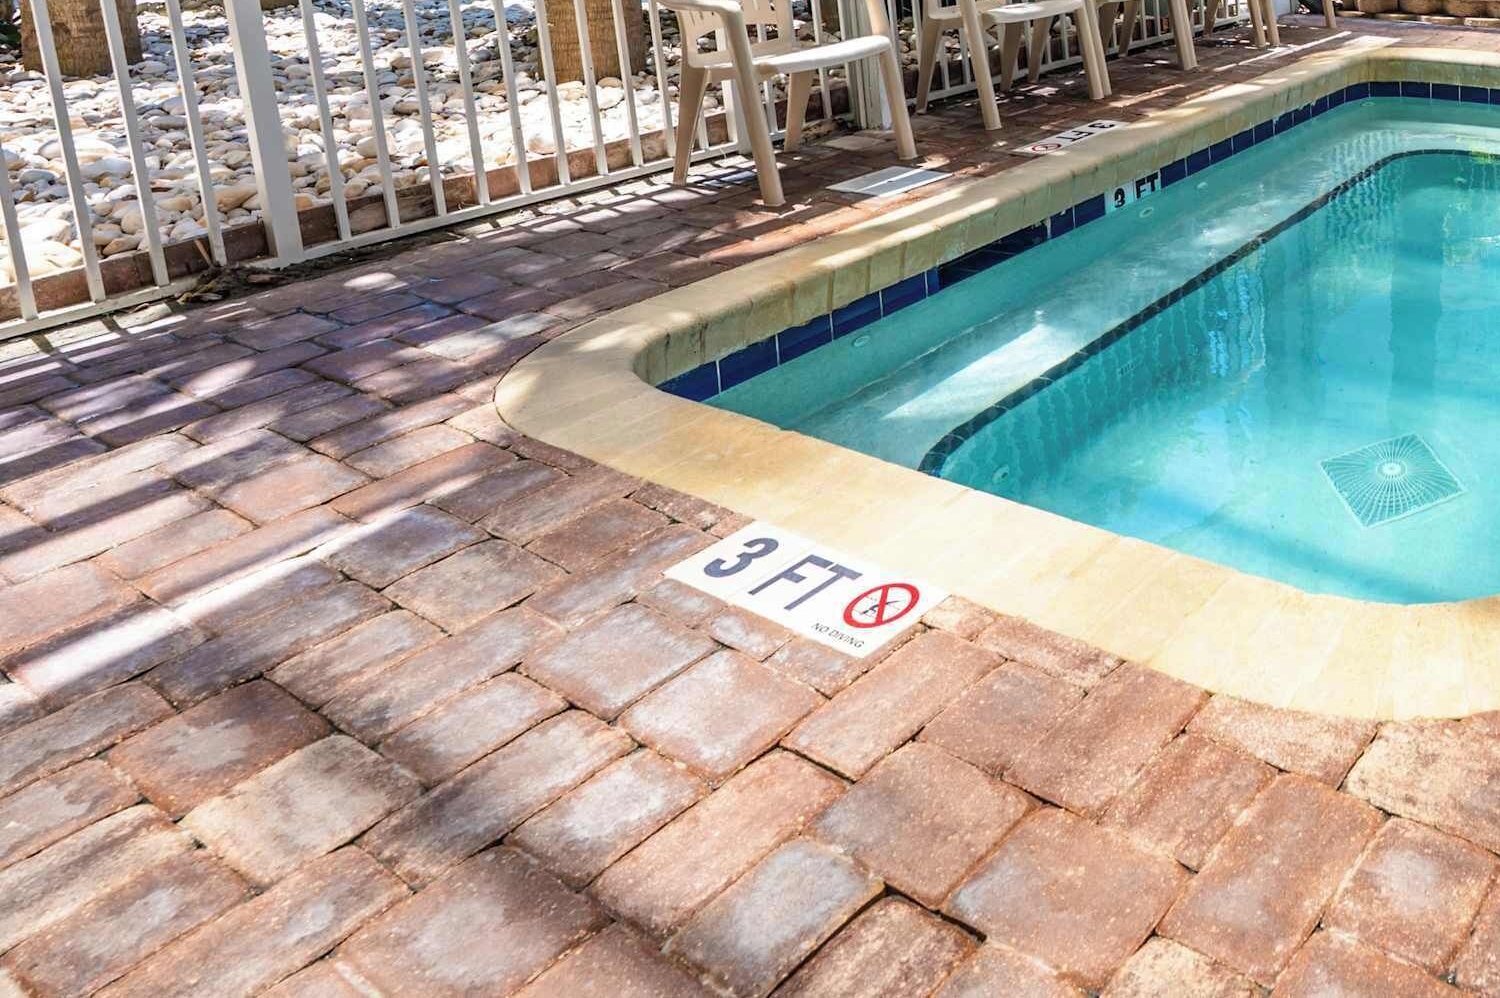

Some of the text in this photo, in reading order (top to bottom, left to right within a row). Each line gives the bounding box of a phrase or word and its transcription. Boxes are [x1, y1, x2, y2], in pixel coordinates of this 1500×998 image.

[1056, 130, 1094, 142] FT
[1115, 171, 1159, 208] 3 FT
[704, 538, 863, 610] 3 FT
[811, 622, 865, 648] NO DIVING
